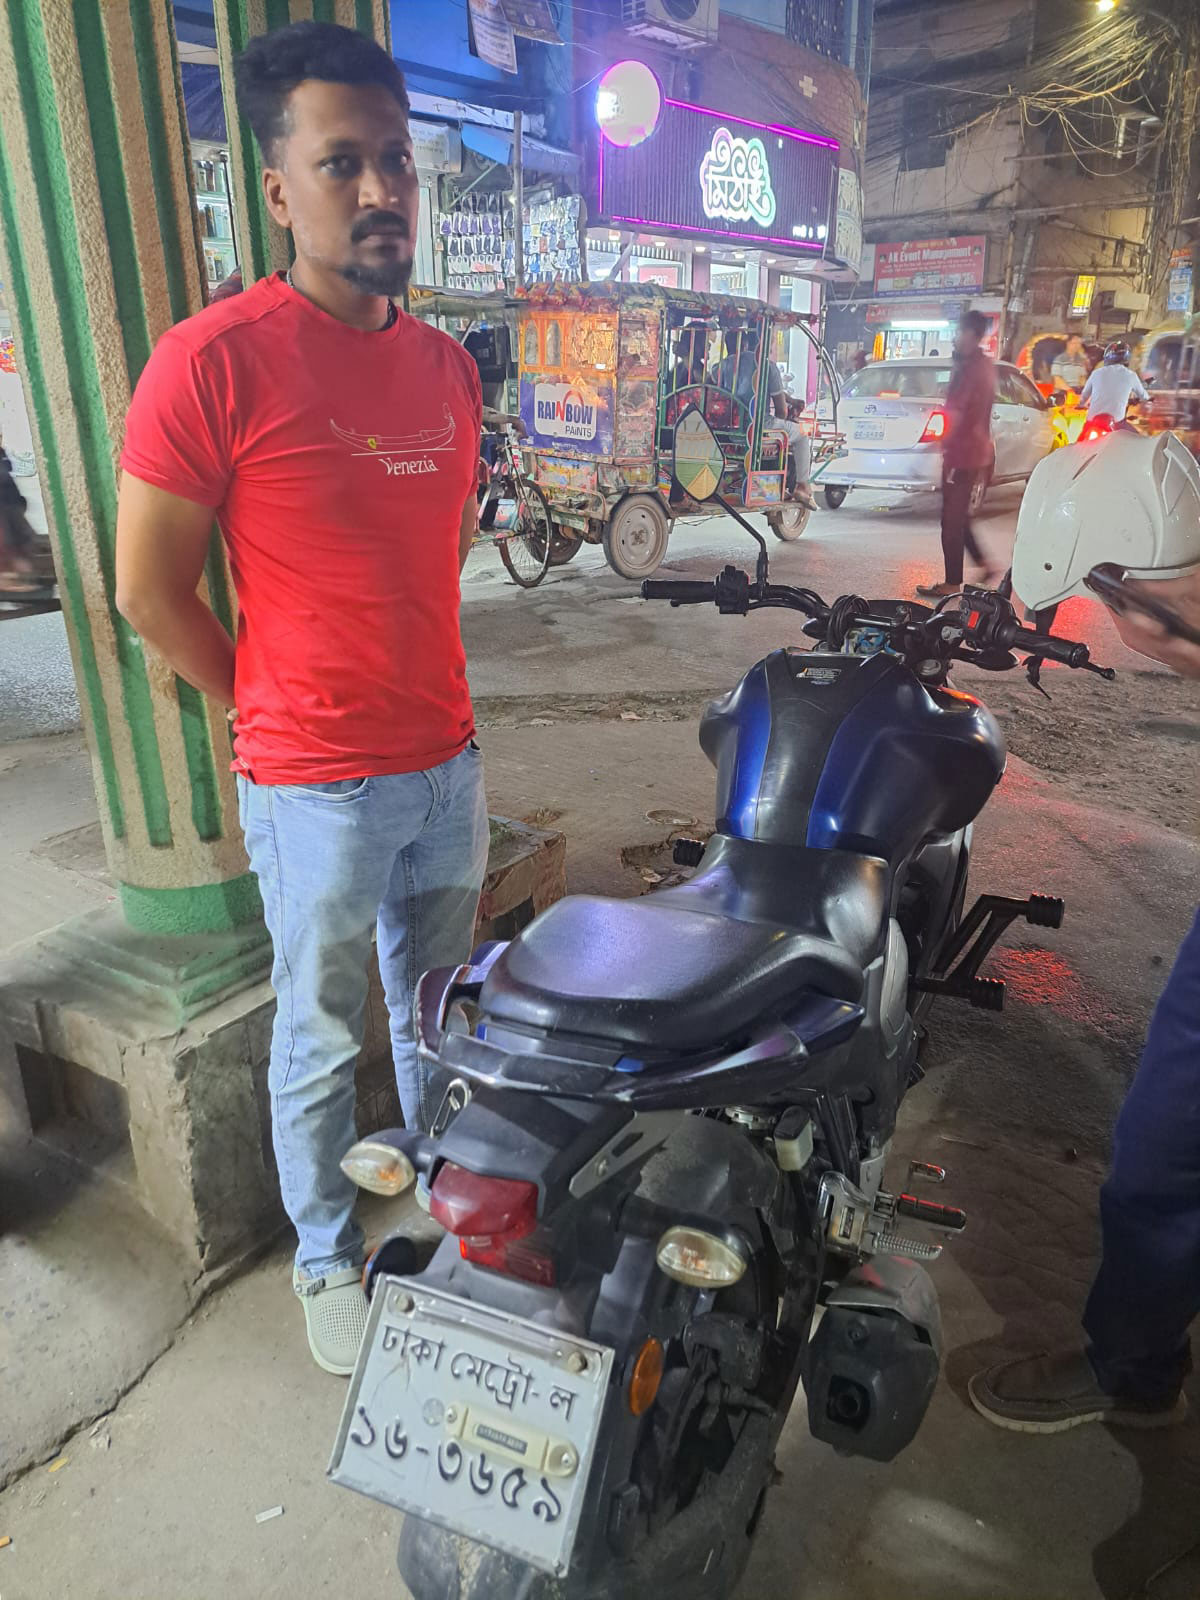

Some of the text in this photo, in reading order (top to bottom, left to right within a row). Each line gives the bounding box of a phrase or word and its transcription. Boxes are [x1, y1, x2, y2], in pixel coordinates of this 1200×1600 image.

[537, 398, 593, 425] RAINBOW
[377, 455, 440, 475] Venezia
[382, 1325, 446, 1370] ঢাকা
[350, 1406, 562, 1523] ১৬-৩৬৫৯
